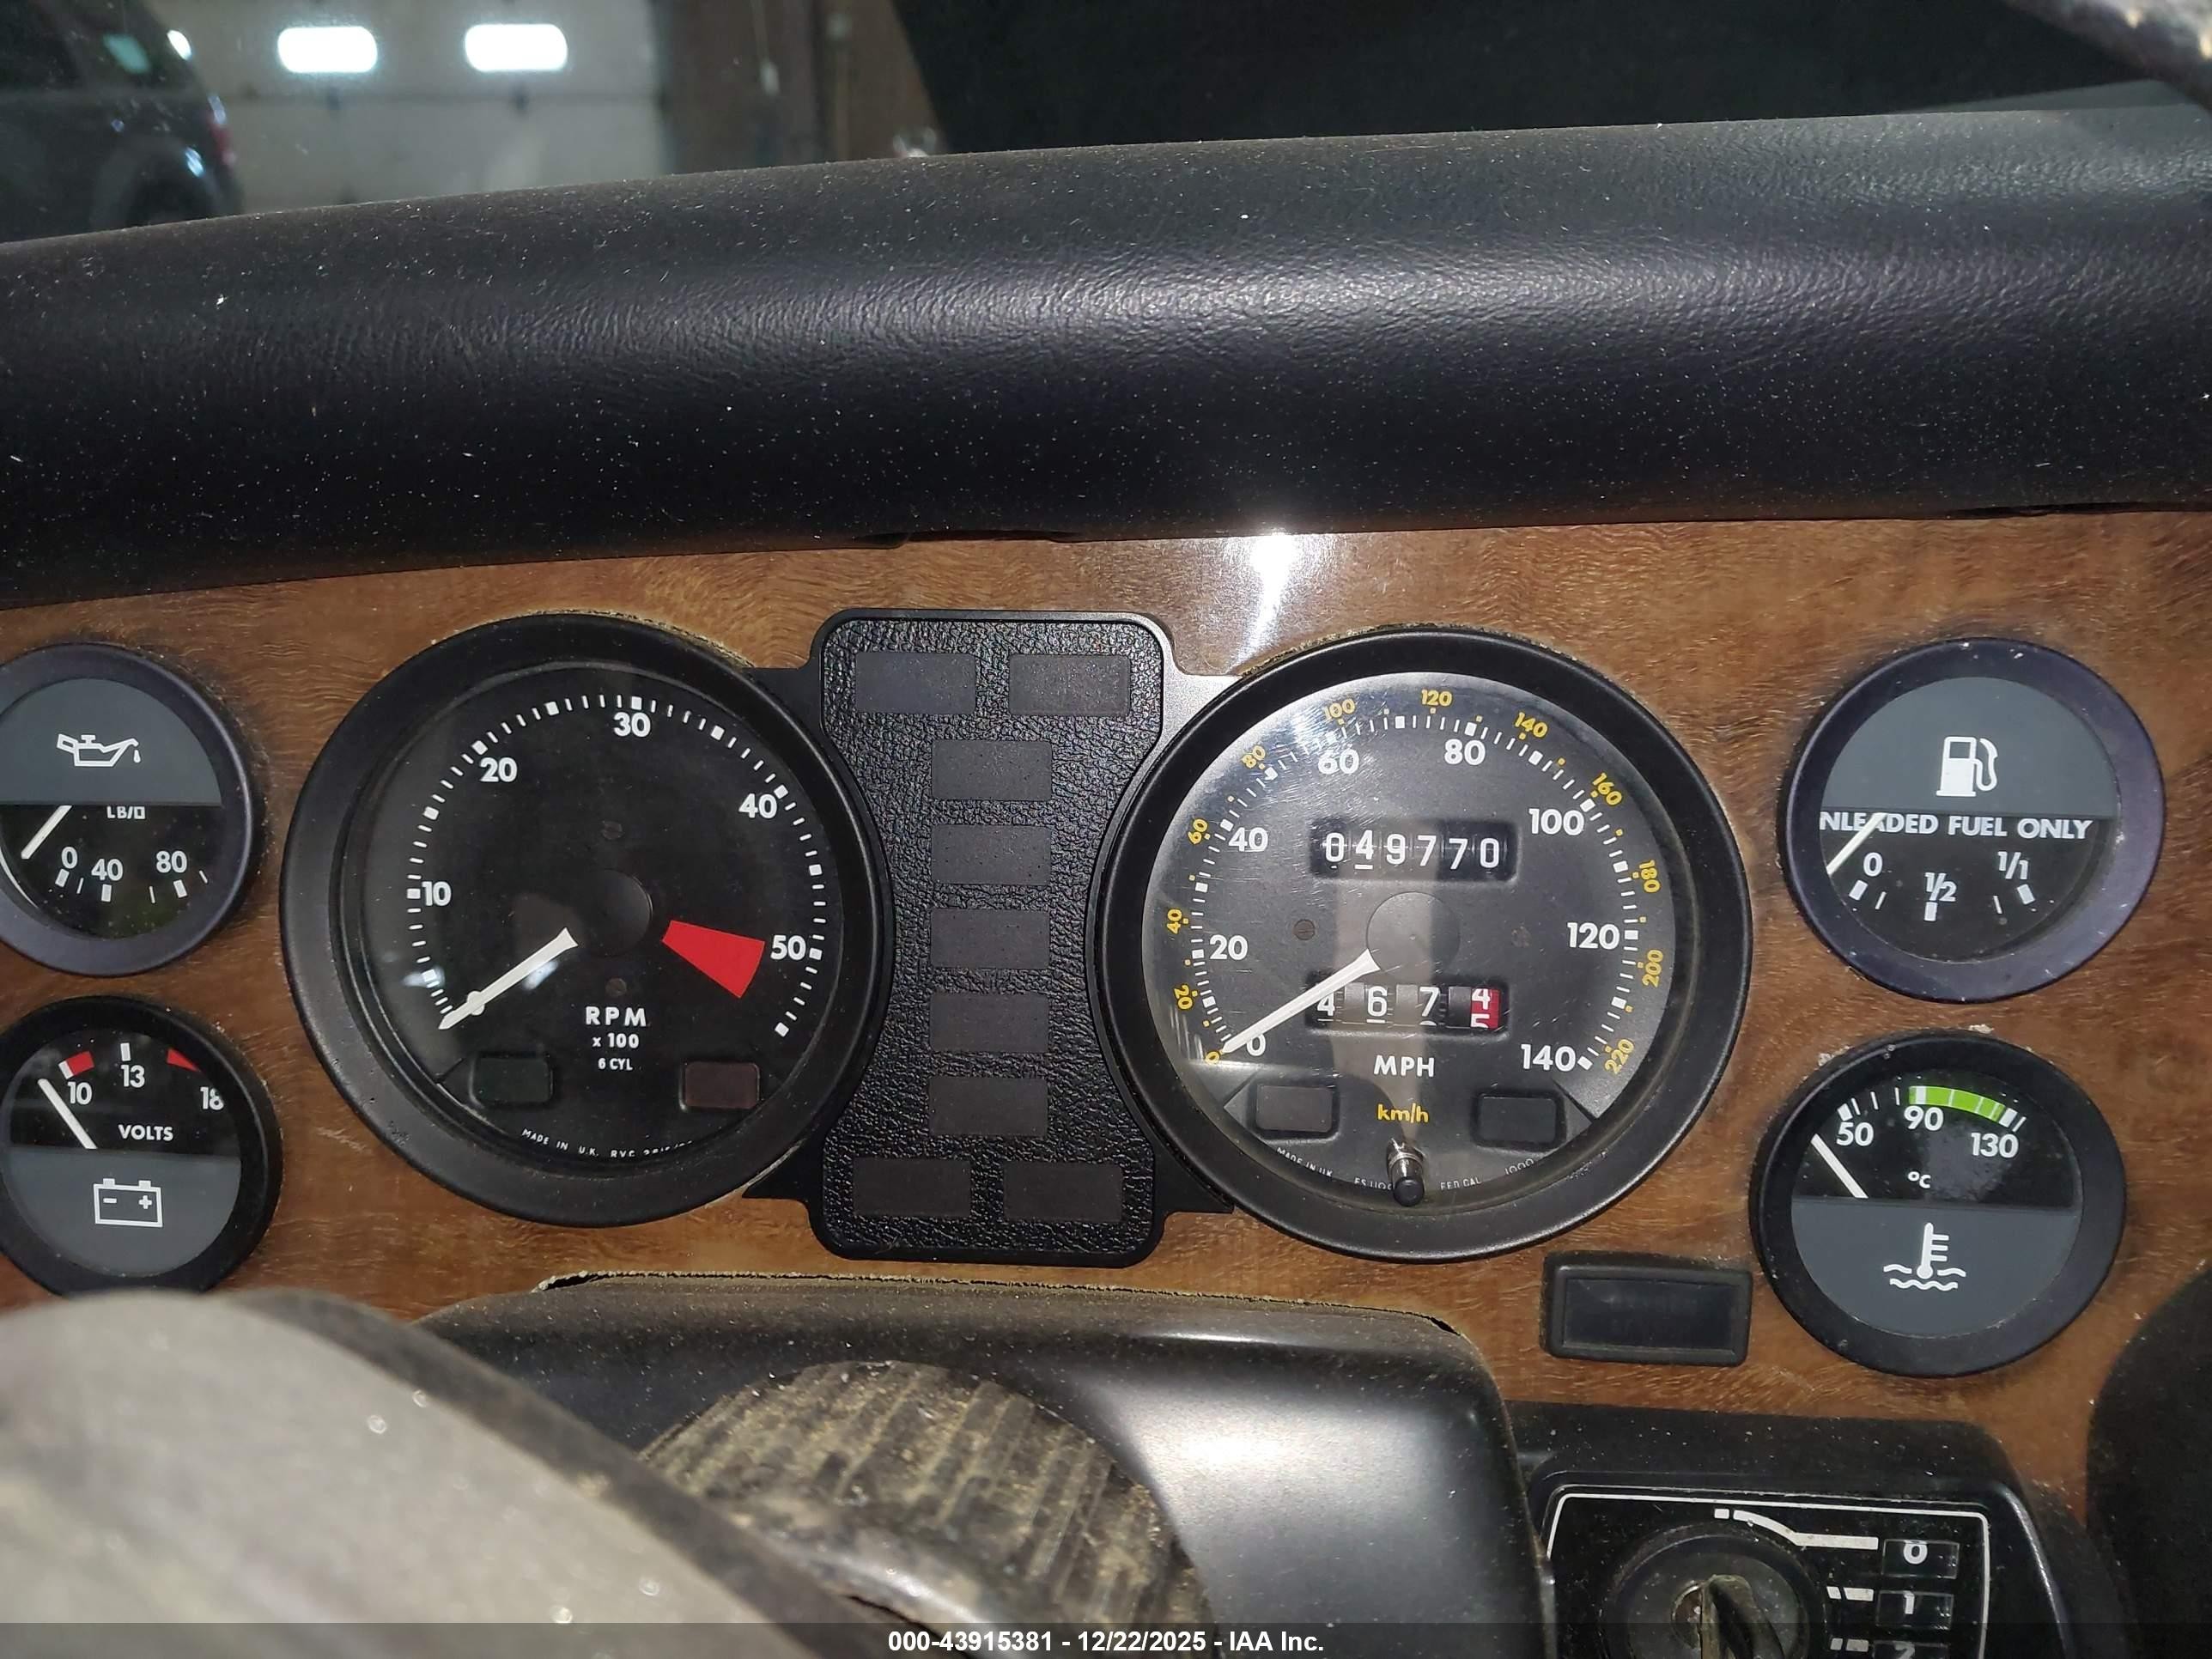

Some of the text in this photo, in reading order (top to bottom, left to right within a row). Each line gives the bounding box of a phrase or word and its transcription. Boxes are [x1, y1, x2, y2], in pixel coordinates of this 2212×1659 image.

[1324, 698, 1356, 720] 100
[1421, 690, 1452, 707] 120
[613, 712, 651, 738] 30
[1515, 712, 1547, 738] 140
[1242, 745, 1266, 769] 80
[1318, 749, 1359, 774] 60
[1444, 738, 1486, 765] 80
[480, 757, 517, 782] 20
[1592, 773, 1622, 805] 160
[739, 793, 777, 818] 40
[1188, 819, 1208, 844] 60
[1528, 808, 1584, 836] 100
[1948, 816, 2008, 837] FUEL
[2018, 818, 2093, 840] ONLY
[1229, 827, 1268, 852] 40
[1325, 830, 1500, 870] 049770
[61, 847, 78, 869] 0
[91, 859, 124, 881] 40
[155, 851, 187, 873] 80
[1863, 853, 1882, 877] 0
[1997, 851, 2028, 879] 1/1
[1639, 860, 1660, 892] 180
[421, 881, 452, 907] 10
[1166, 908, 1182, 934] 40
[770, 934, 806, 960] 50
[1209, 934, 1249, 960] 20
[1567, 922, 1620, 950] 120
[1642, 950, 1663, 988] 200
[1174, 985, 1193, 1010] 20
[586, 1006, 647, 1026] RPM
[607, 1032, 639, 1048] 100
[1246, 1033, 1267, 1056] 0
[598, 1058, 633, 1071] 6 CYL
[1205, 1050, 1221, 1065] 0
[1374, 1054, 1435, 1077] MPH
[1521, 1043, 1576, 1072] 140
[1604, 1038, 1634, 1074] 220
[120, 1064, 145, 1088] 13
[68, 1081, 93, 1105] 10
[200, 1086, 224, 1110] 18
[1377, 1103, 1429, 1123] km/h
[1903, 1105, 1944, 1131] 90
[118, 1124, 173, 1141] VOLTS
[522, 1128, 550, 1145] MADE
[556, 1141, 568, 1151] IN
[1836, 1121, 1874, 1146] 50
[1971, 1133, 2018, 1158] 130
[1305, 1162, 1316, 1171] IN
[1903, 1540, 1928, 1565] 0
[1903, 1590, 1915, 1614] 1
